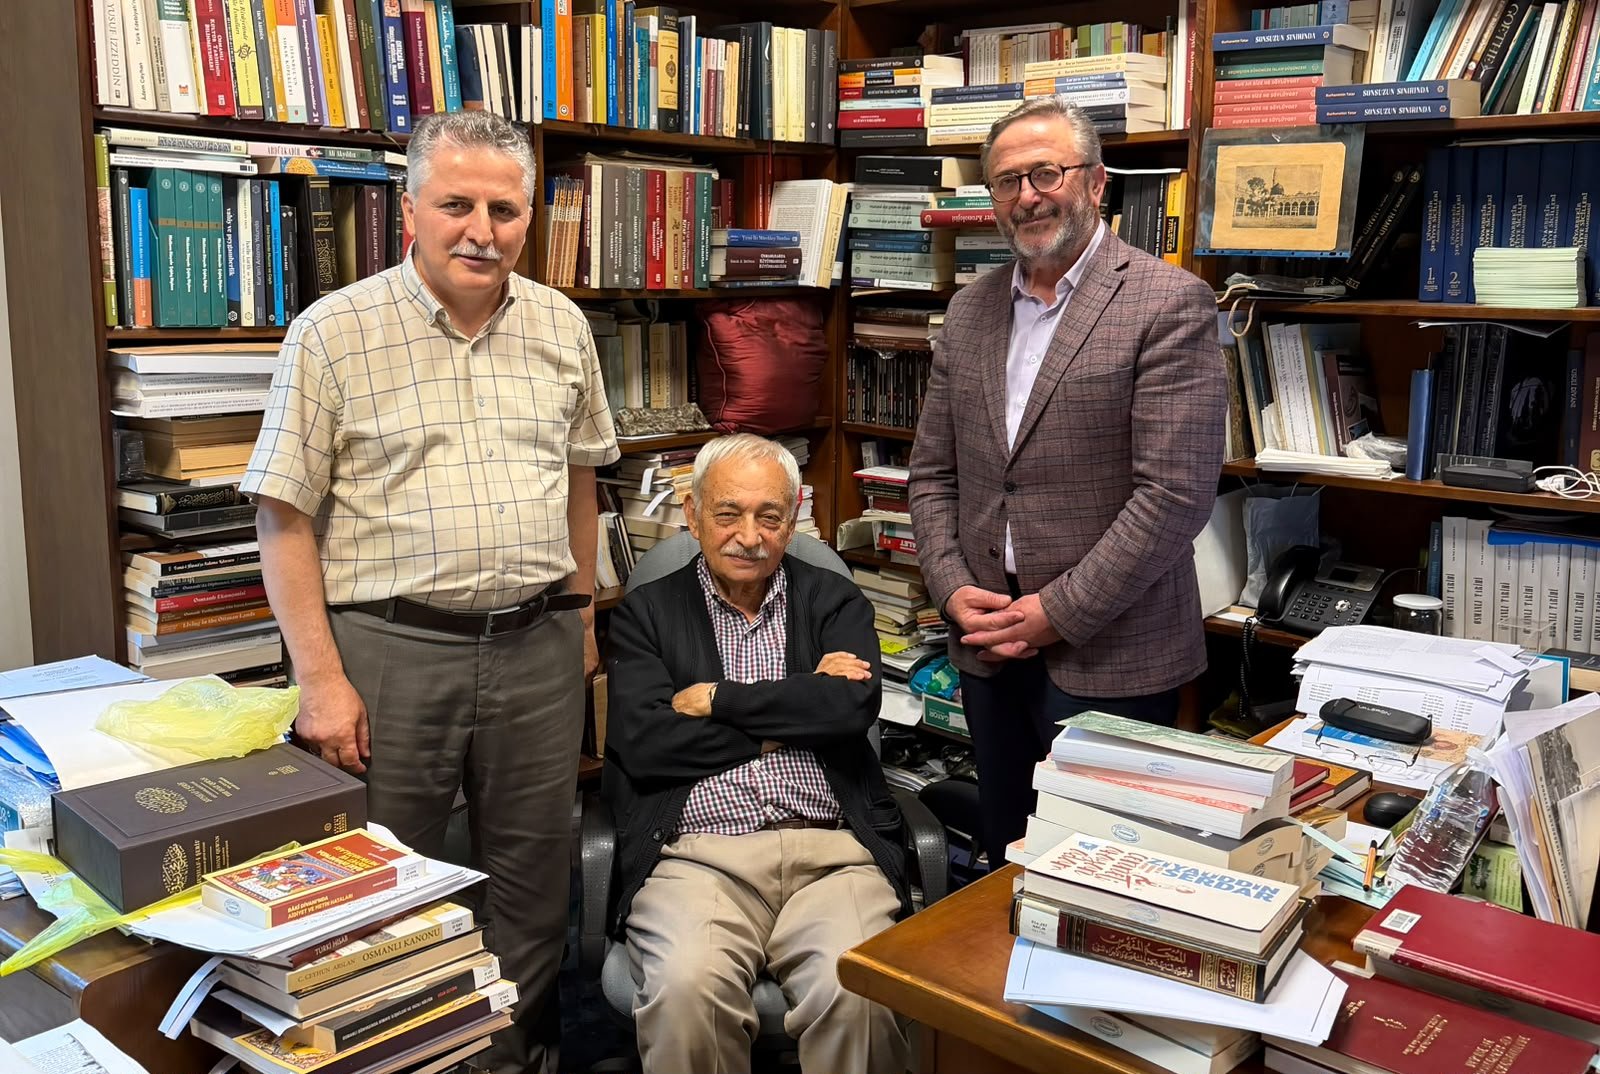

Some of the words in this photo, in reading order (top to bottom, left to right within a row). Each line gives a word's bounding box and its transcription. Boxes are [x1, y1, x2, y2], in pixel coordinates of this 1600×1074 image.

[107, 3, 117, 35] YUSUF
[1486, 3, 1519, 65] GOETHE
[1450, 271, 1461, 285] 2.
[1474, 600, 1482, 624] OSMANLI
[1574, 616, 1582, 641] OSMANLI
[1162, 868, 1276, 903] SERDAR
[362, 942, 404, 962] OSMANLI
[404, 928, 441, 951] KANONU
[304, 967, 332, 981] CEYHUN
[333, 959, 356, 973] ARSLAN
